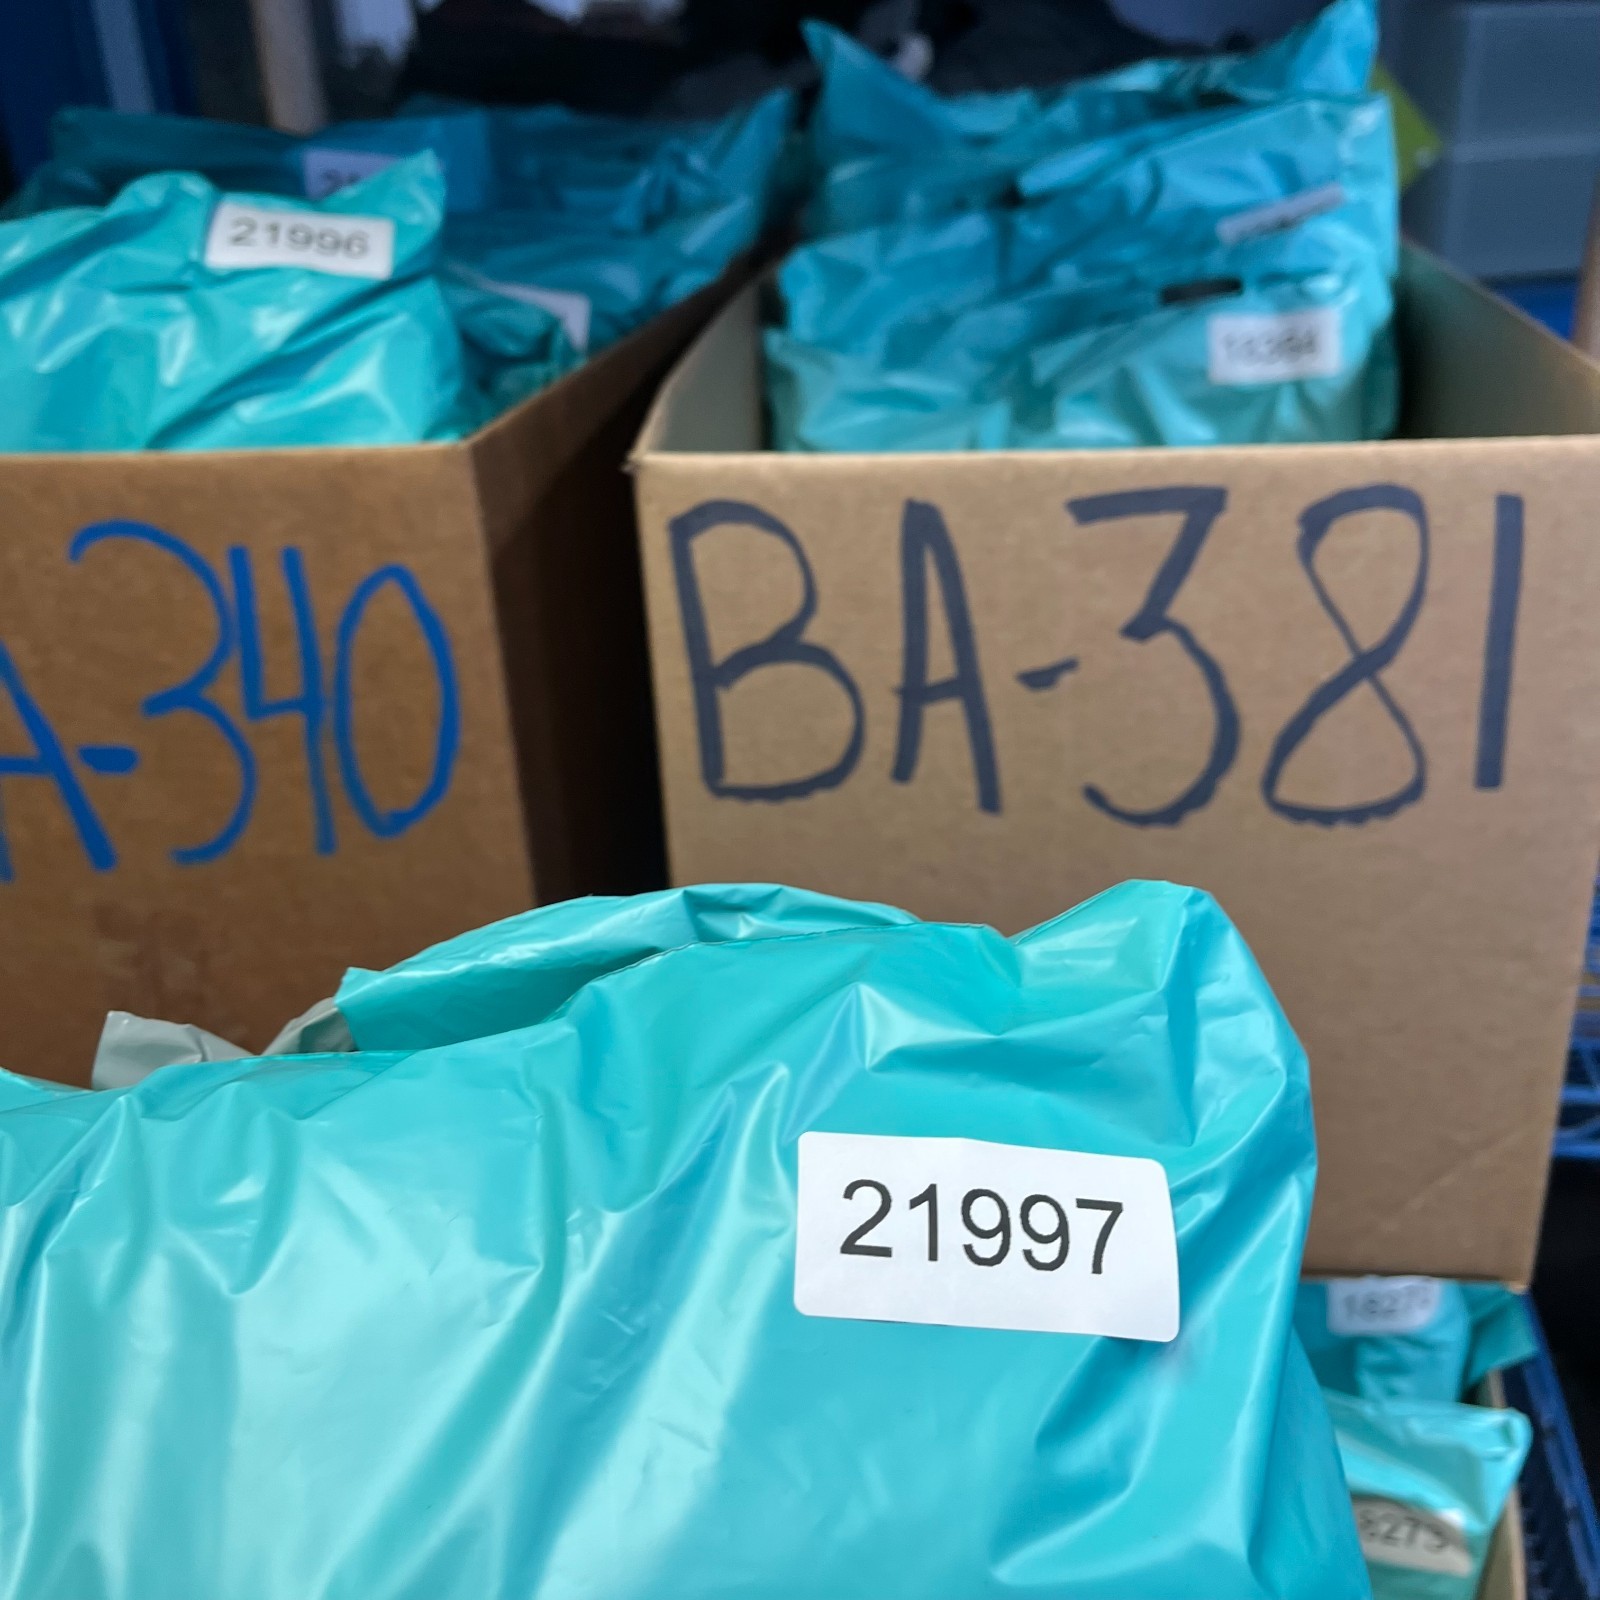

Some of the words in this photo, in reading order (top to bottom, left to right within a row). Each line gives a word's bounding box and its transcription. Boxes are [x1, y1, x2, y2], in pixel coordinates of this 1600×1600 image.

[229, 215, 370, 260] 21996
[668, 483, 1524, 828] BA-381
[840, 1178, 1124, 1276] 21997
